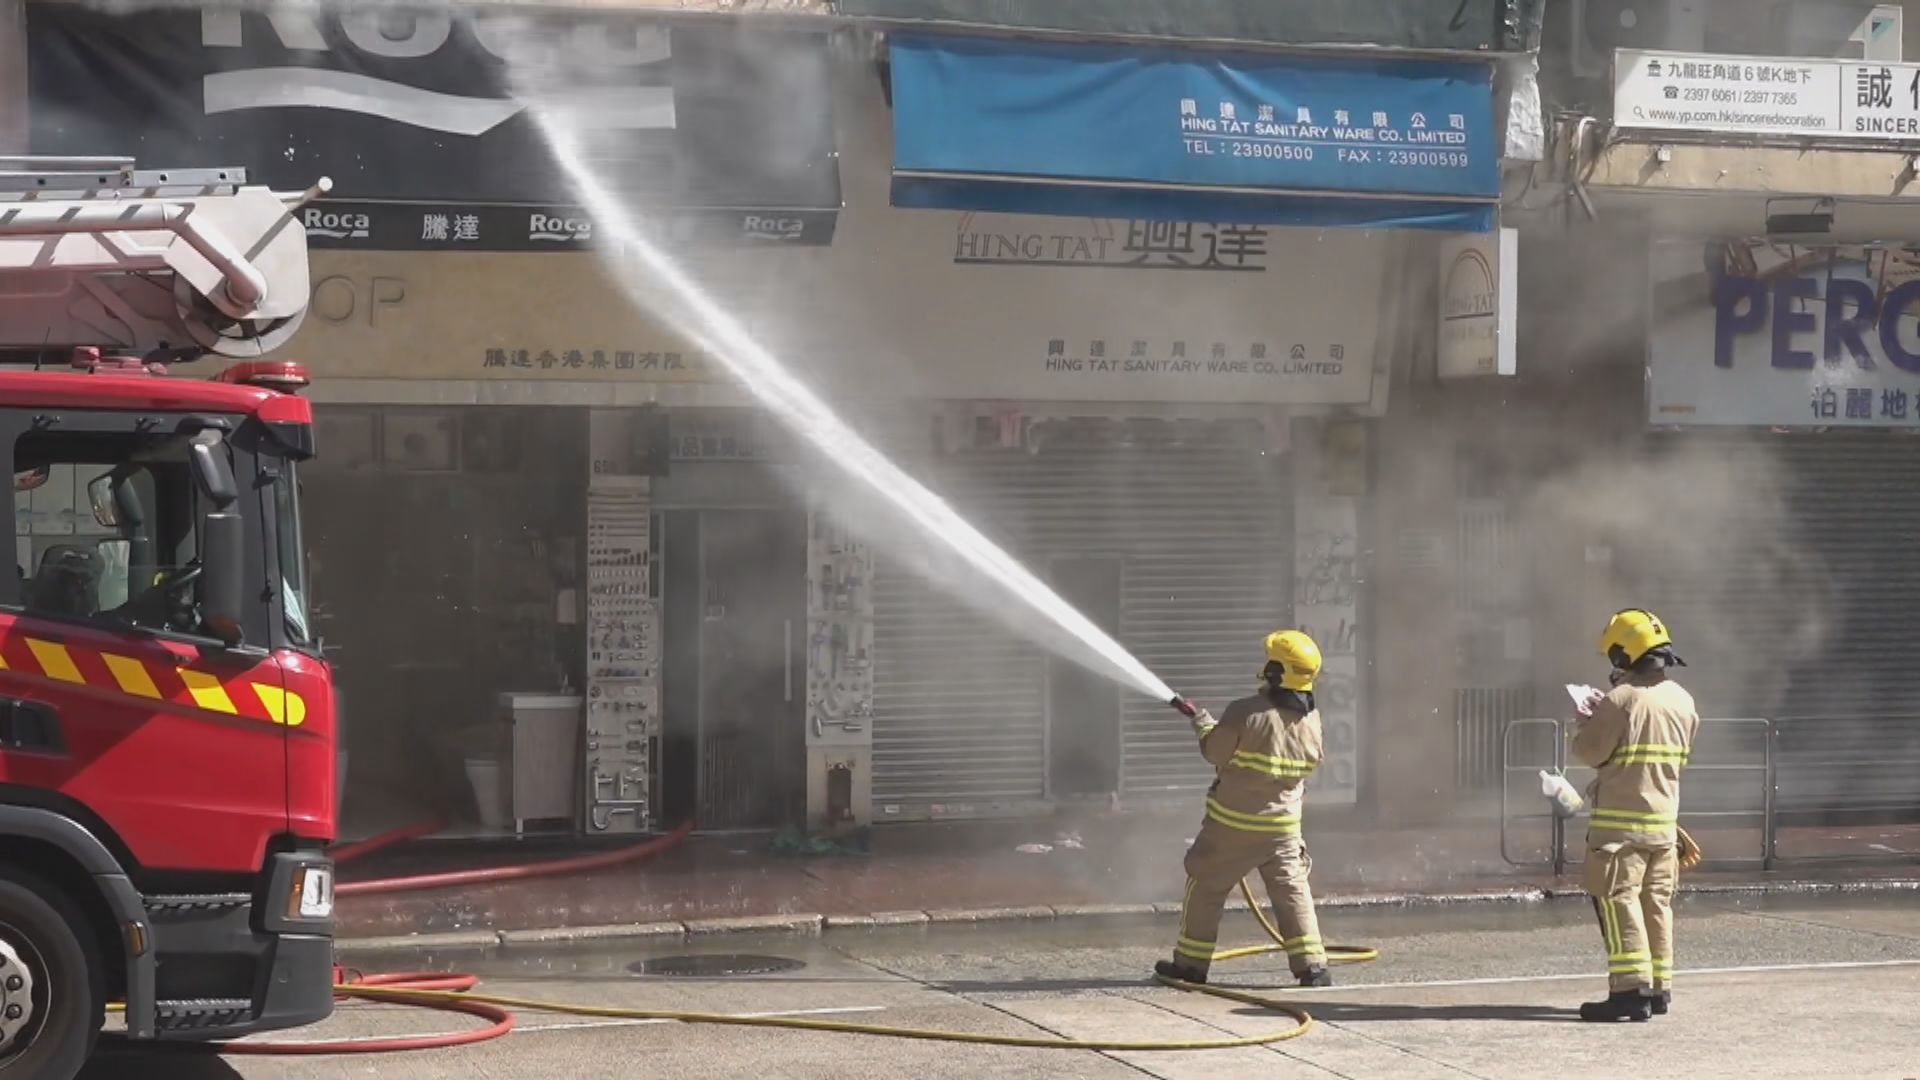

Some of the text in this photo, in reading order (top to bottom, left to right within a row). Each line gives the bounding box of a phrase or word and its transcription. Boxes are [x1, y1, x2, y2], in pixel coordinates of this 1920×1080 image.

[1181, 118, 1466, 143] HING TAT SANITARY WARE CO. LIMITED
[1233, 142, 1312, 160] 23900500
[1389, 150, 1468, 167] 23900599
[305, 208, 804, 241] Roca 騰達 Roca Roca
[956, 233, 1042, 259] HING
[1051, 236, 1114, 259] TAT
[1046, 358, 1083, 371] HING
[1089, 360, 1118, 372] TAT
[1123, 360, 1201, 373] SANITARY
[1207, 361, 1248, 374] WARE
[1283, 362, 1343, 375] LIMITED
